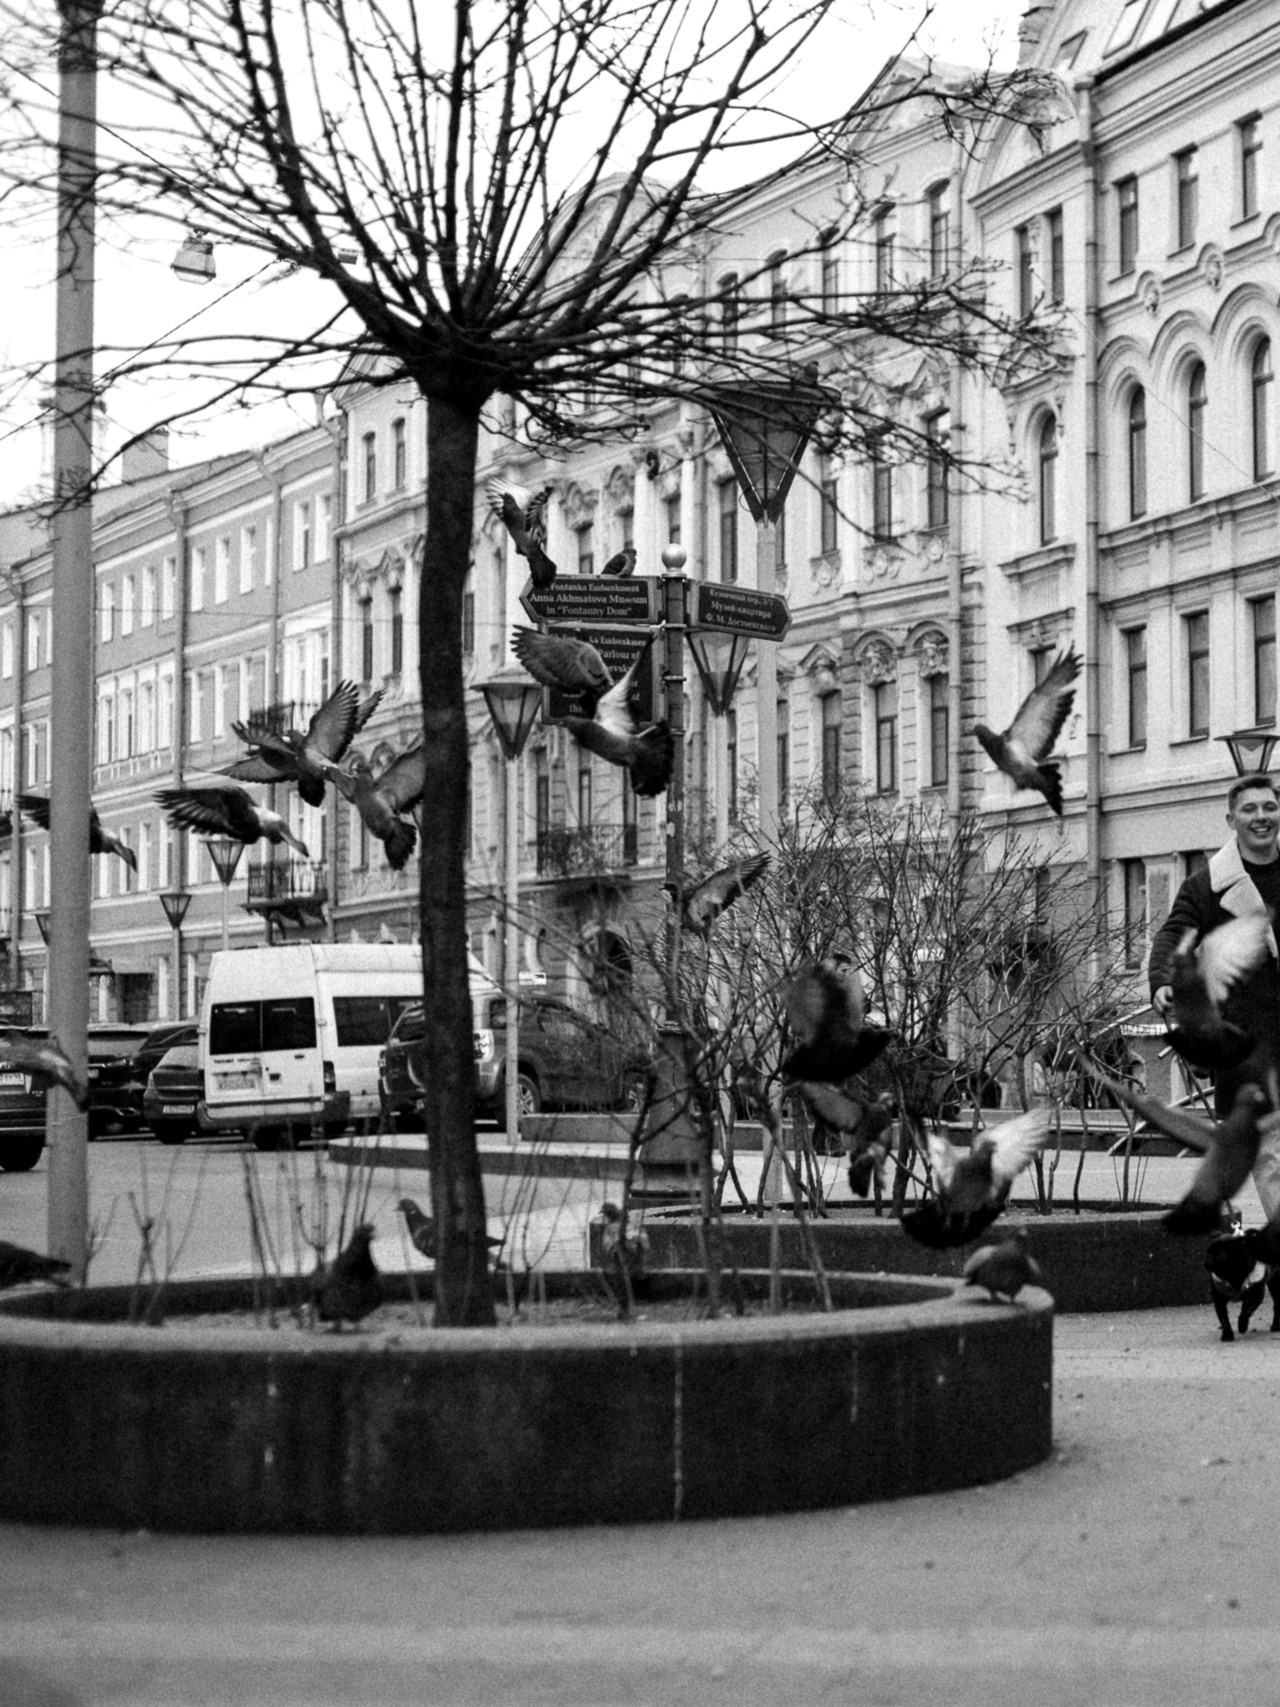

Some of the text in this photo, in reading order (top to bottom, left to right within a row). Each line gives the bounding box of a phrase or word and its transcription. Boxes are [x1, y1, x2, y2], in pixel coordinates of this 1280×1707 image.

[550, 582, 639, 592] Fontanka Embankment
[530, 593, 647, 604] Anna Akhmatova Museum
[709, 588, 746, 602] Кузнечный
[547, 605, 555, 614] in
[711, 601, 772, 619] Музей-квартира
[705, 613, 776, 632] Ф. М. Достоевского
[601, 636, 647, 647] Embankmen
